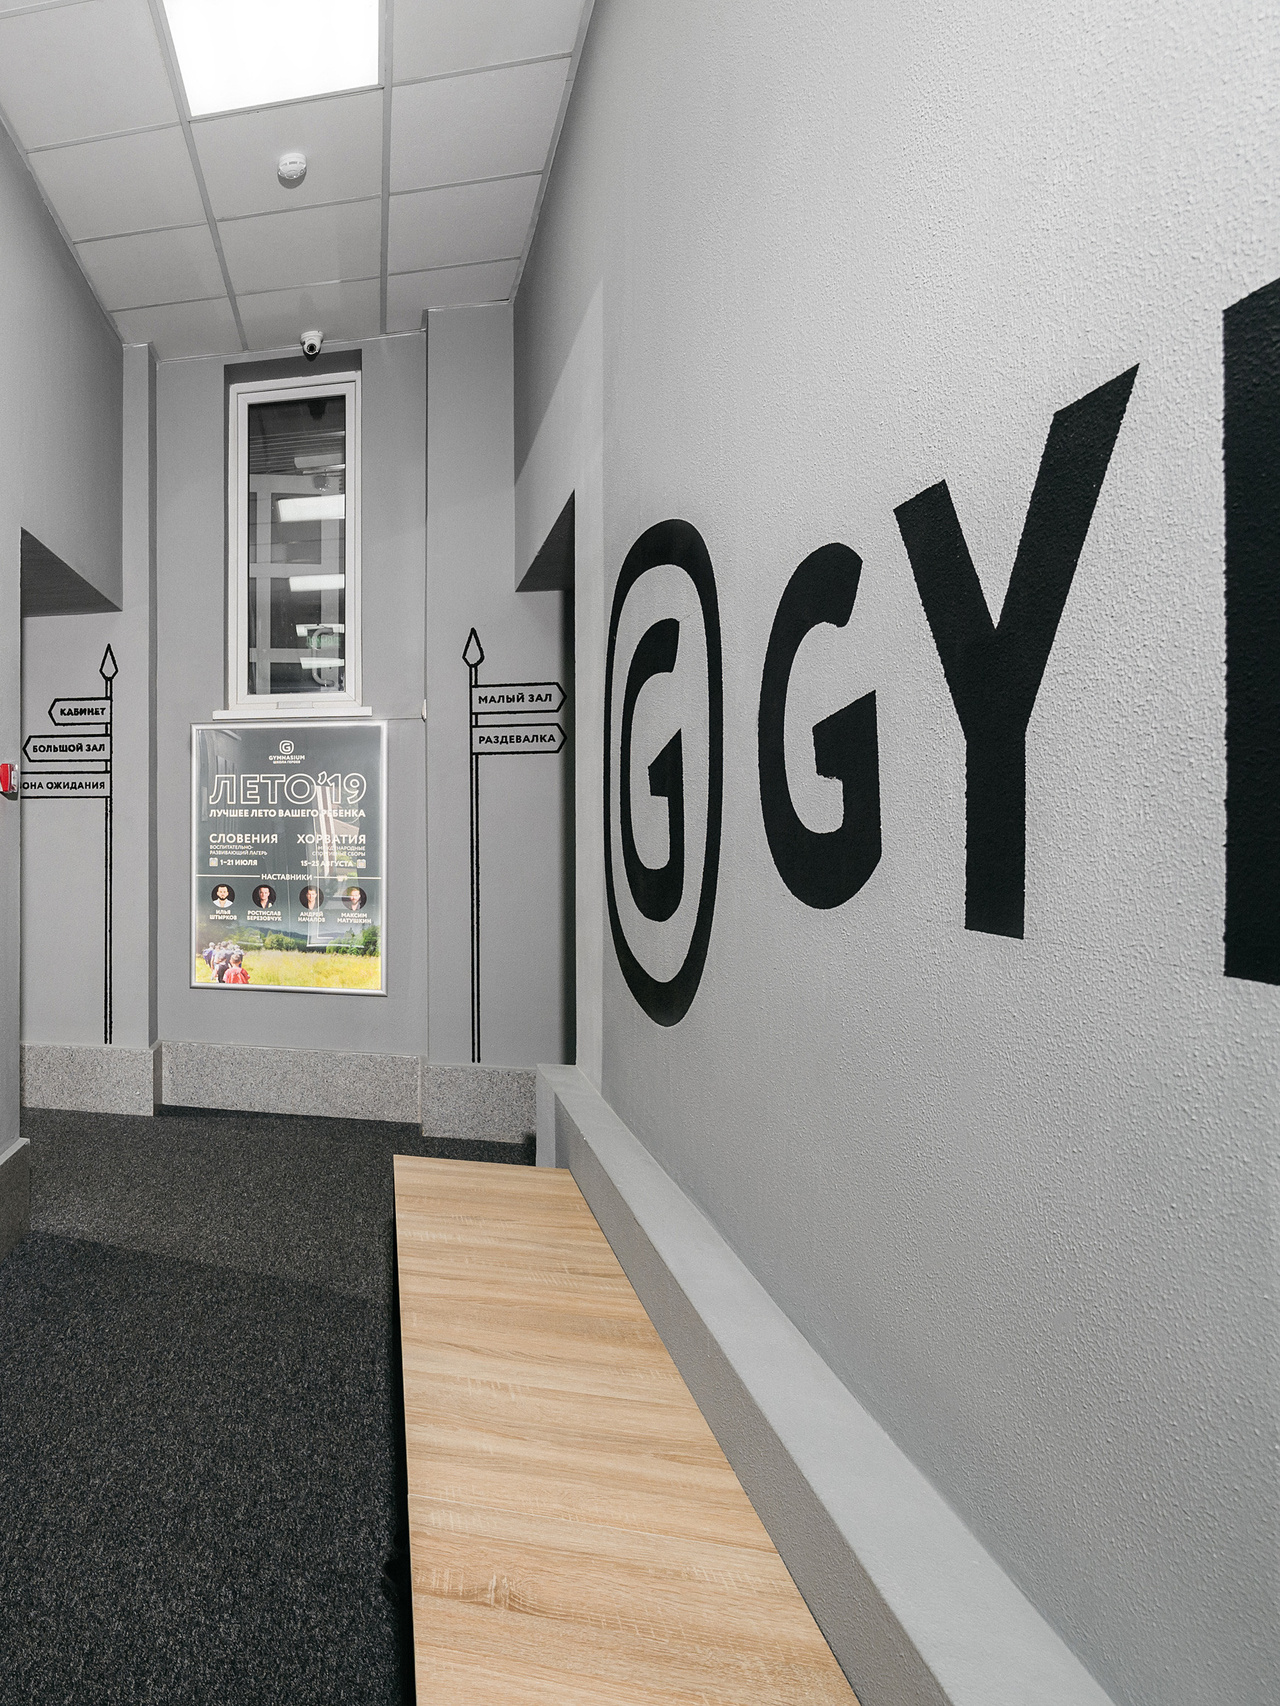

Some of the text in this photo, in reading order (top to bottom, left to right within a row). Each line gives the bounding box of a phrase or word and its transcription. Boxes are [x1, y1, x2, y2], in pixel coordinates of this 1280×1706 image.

[758, 278, 1280, 985] GY
[478, 692, 553, 704] МАЛЫЙ ЗАЛ
[60, 707, 106, 716] КАБИНЕТ
[478, 734, 556, 745] РАЗДЕВАЛКА
[32, 742, 105, 753] БОЛЬШОЙ ЗАЛ
[20, 781, 106, 791] ОНА ОЖИДАНИЯ
[209, 808, 249, 818] ЛУЧШЕЕ
[250, 808, 277, 818] ЛЕТО
[278, 808, 319, 818] ВАШЕГО
[209, 833, 279, 844] СЛОВЕНИЯ
[296, 833, 366, 845] ХОРВАТИЯ
[261, 873, 313, 881] НАСТАВНИКИ
